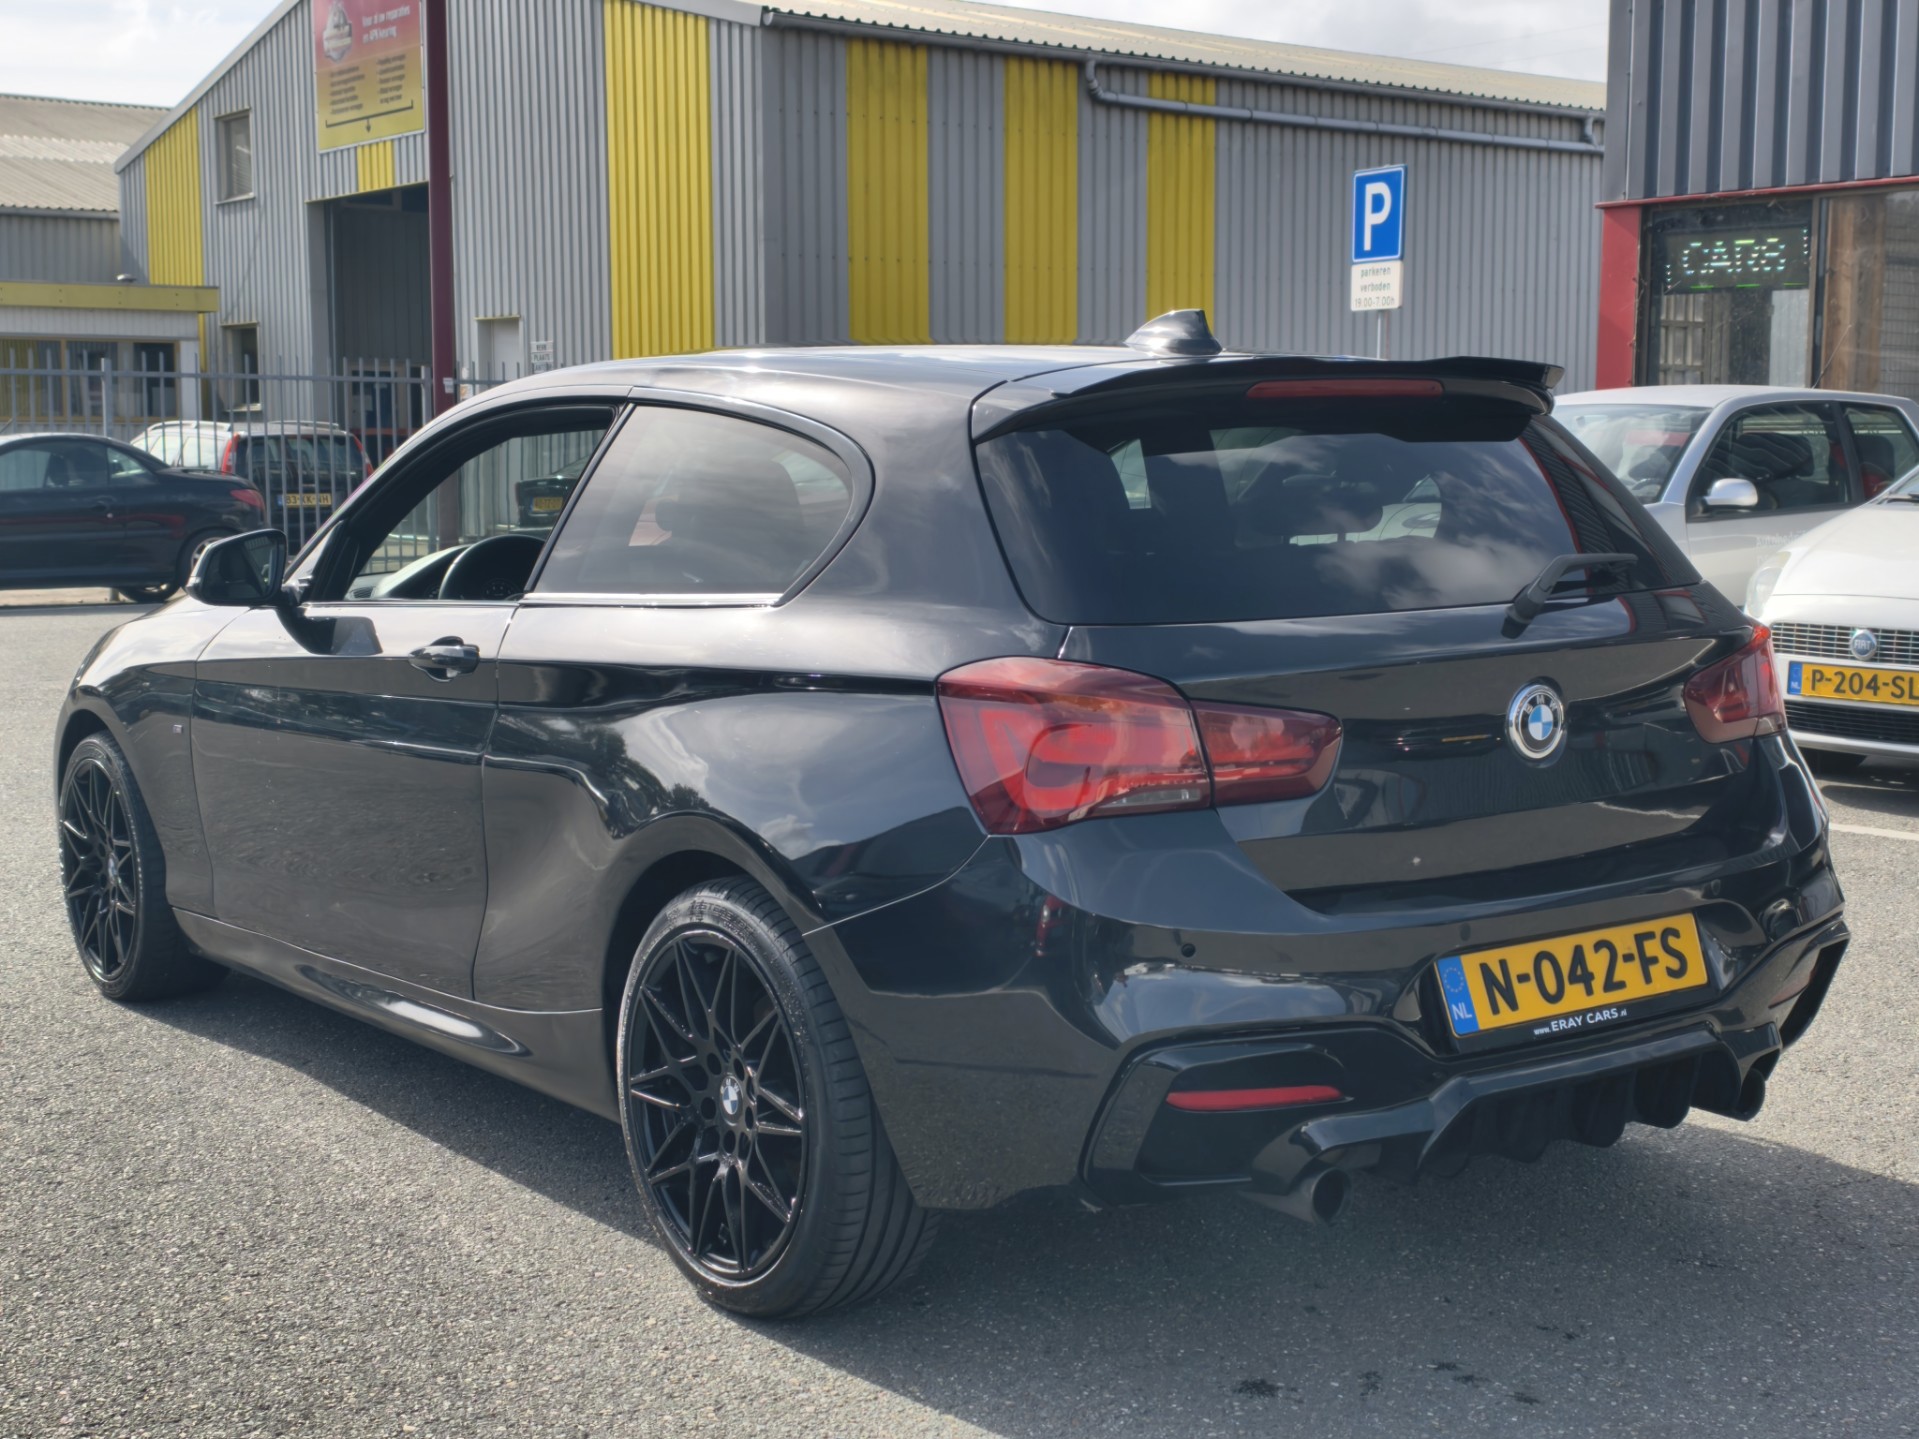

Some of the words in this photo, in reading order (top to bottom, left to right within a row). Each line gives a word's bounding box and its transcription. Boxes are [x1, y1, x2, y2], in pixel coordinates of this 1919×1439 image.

[1363, 181, 1392, 251] P
[1811, 669, 1919, 700] P-204-SL
[1479, 926, 1689, 1016] N-042-FS
[1451, 1003, 1473, 1021] NL
